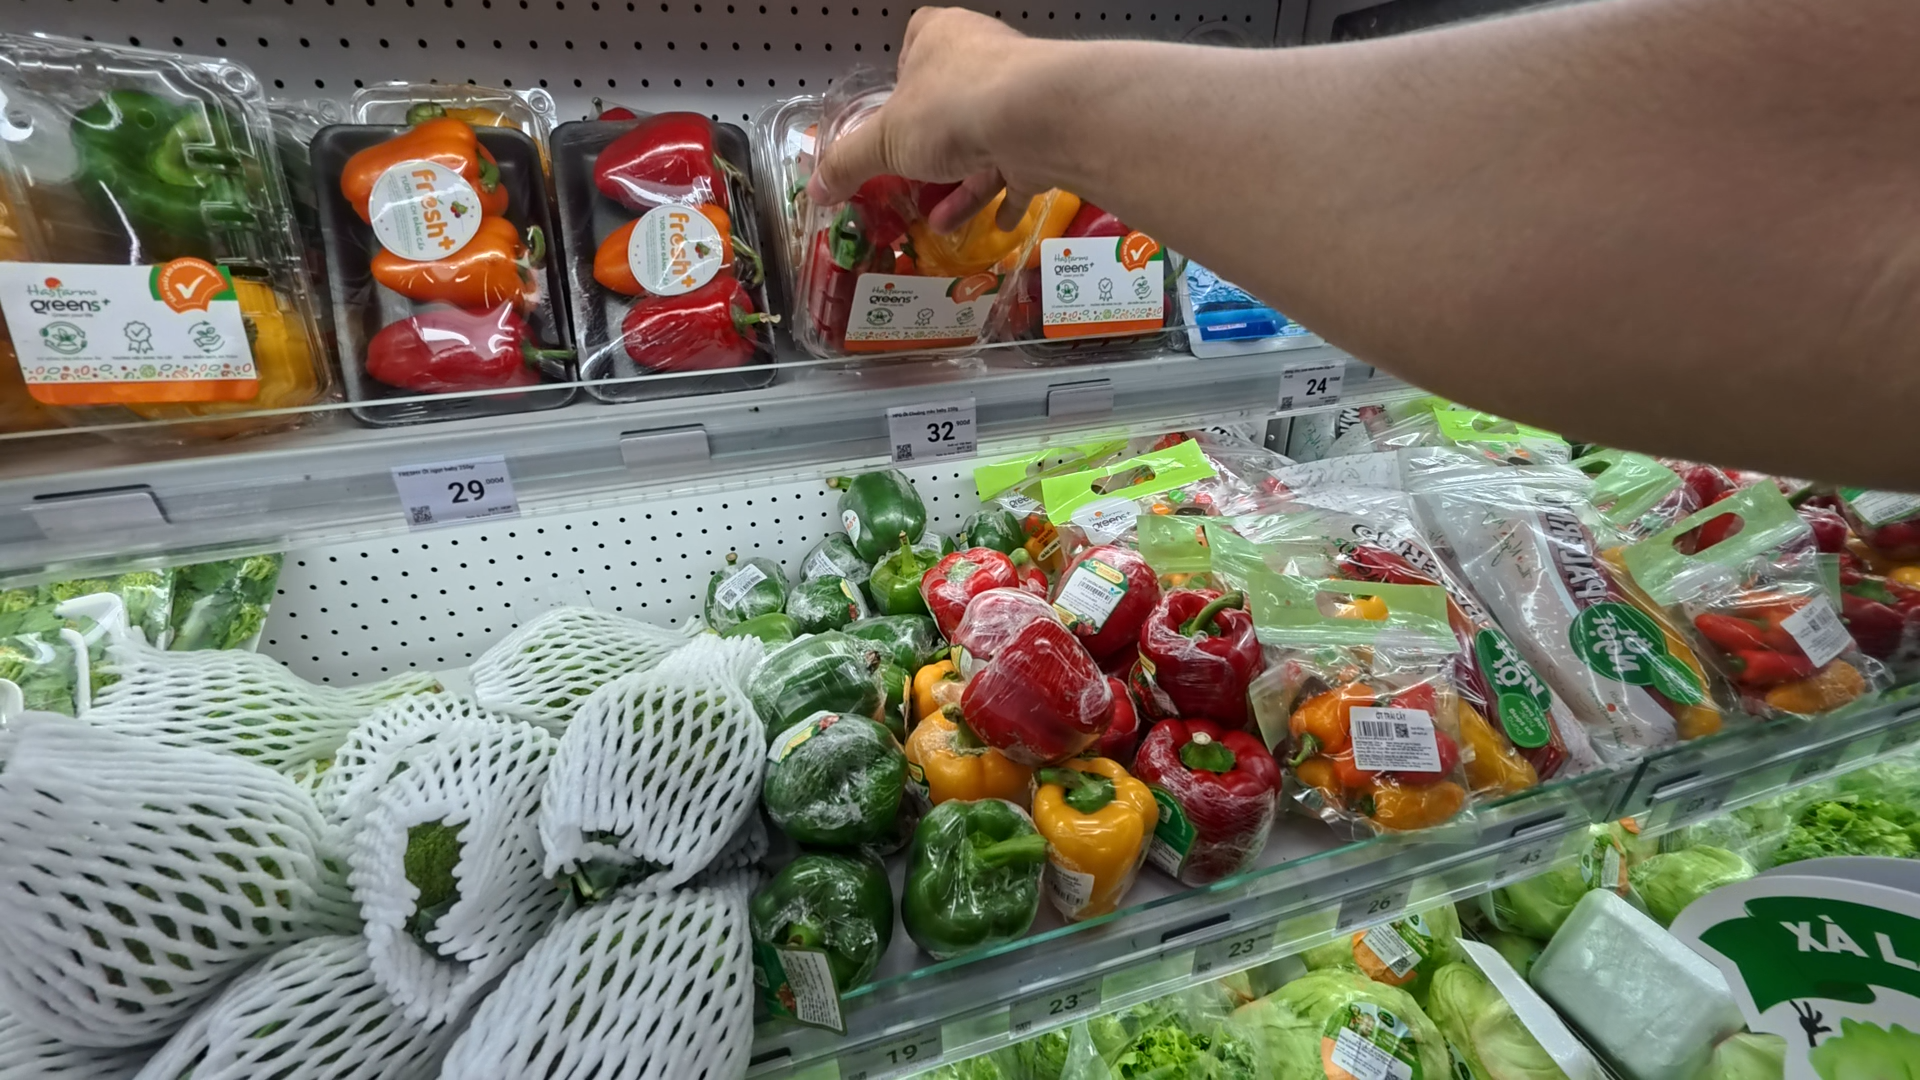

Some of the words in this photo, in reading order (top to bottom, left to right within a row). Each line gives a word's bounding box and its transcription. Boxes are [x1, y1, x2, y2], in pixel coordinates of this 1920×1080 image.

[408, 195, 417, 215] SCH
[1306, 378, 1327, 396] 24
[926, 422, 955, 442] 32
[448, 480, 485, 504] 29
[1492, 656, 1521, 687] Ớt
[1496, 640, 1545, 696] Ngọt
[1367, 896, 1391, 914] 26
[1779, 914, 1870, 958] XÀ
[1228, 938, 1255, 958] 23
[1049, 994, 1078, 1015] 23
[886, 1044, 918, 1064] 19
